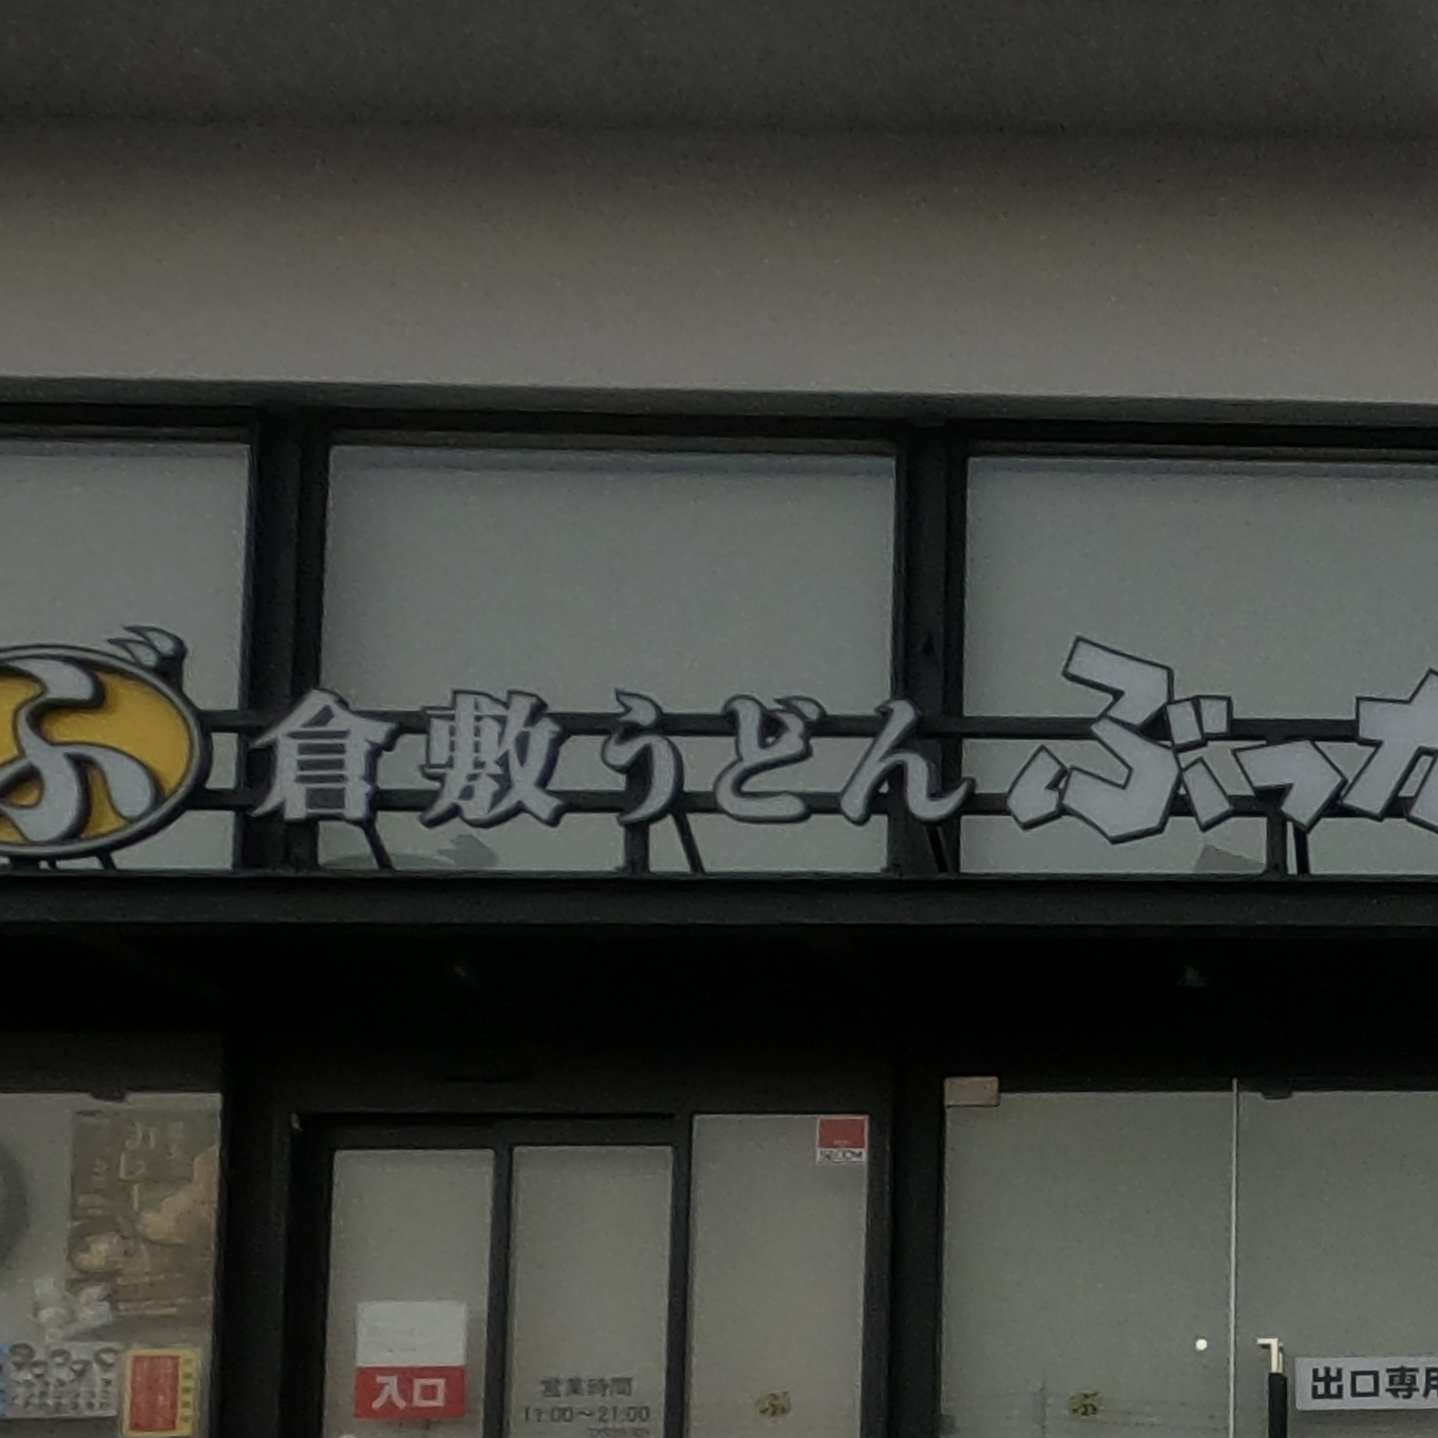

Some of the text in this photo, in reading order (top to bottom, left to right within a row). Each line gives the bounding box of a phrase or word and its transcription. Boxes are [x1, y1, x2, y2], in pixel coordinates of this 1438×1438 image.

[253, 687, 974, 829] 倉敷うどん
[371, 1374, 447, 1410] 入口
